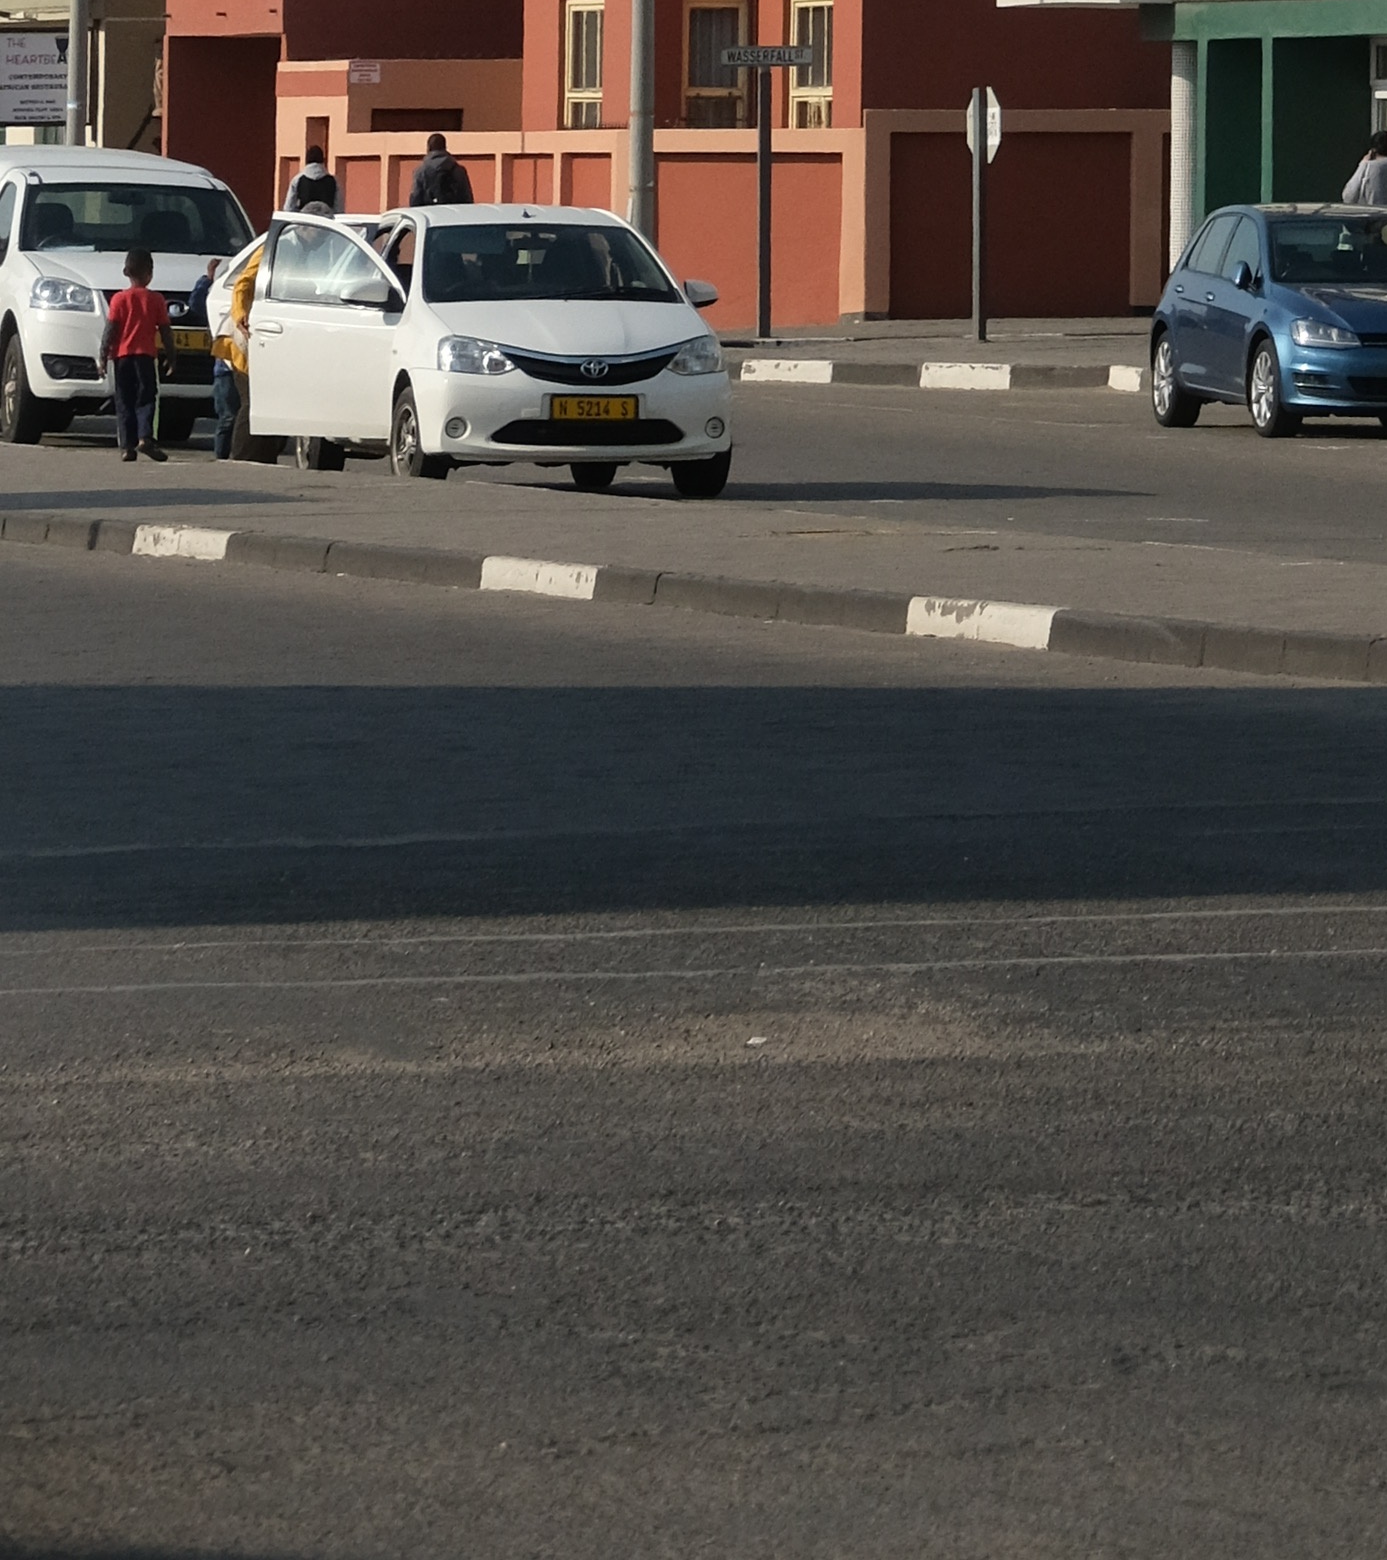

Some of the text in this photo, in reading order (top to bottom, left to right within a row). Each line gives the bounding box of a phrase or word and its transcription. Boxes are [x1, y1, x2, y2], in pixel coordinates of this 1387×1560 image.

[7, 37, 26, 49] THE
[727, 49, 794, 63] WASSERFALL
[559, 400, 629, 417] N 5214 S
